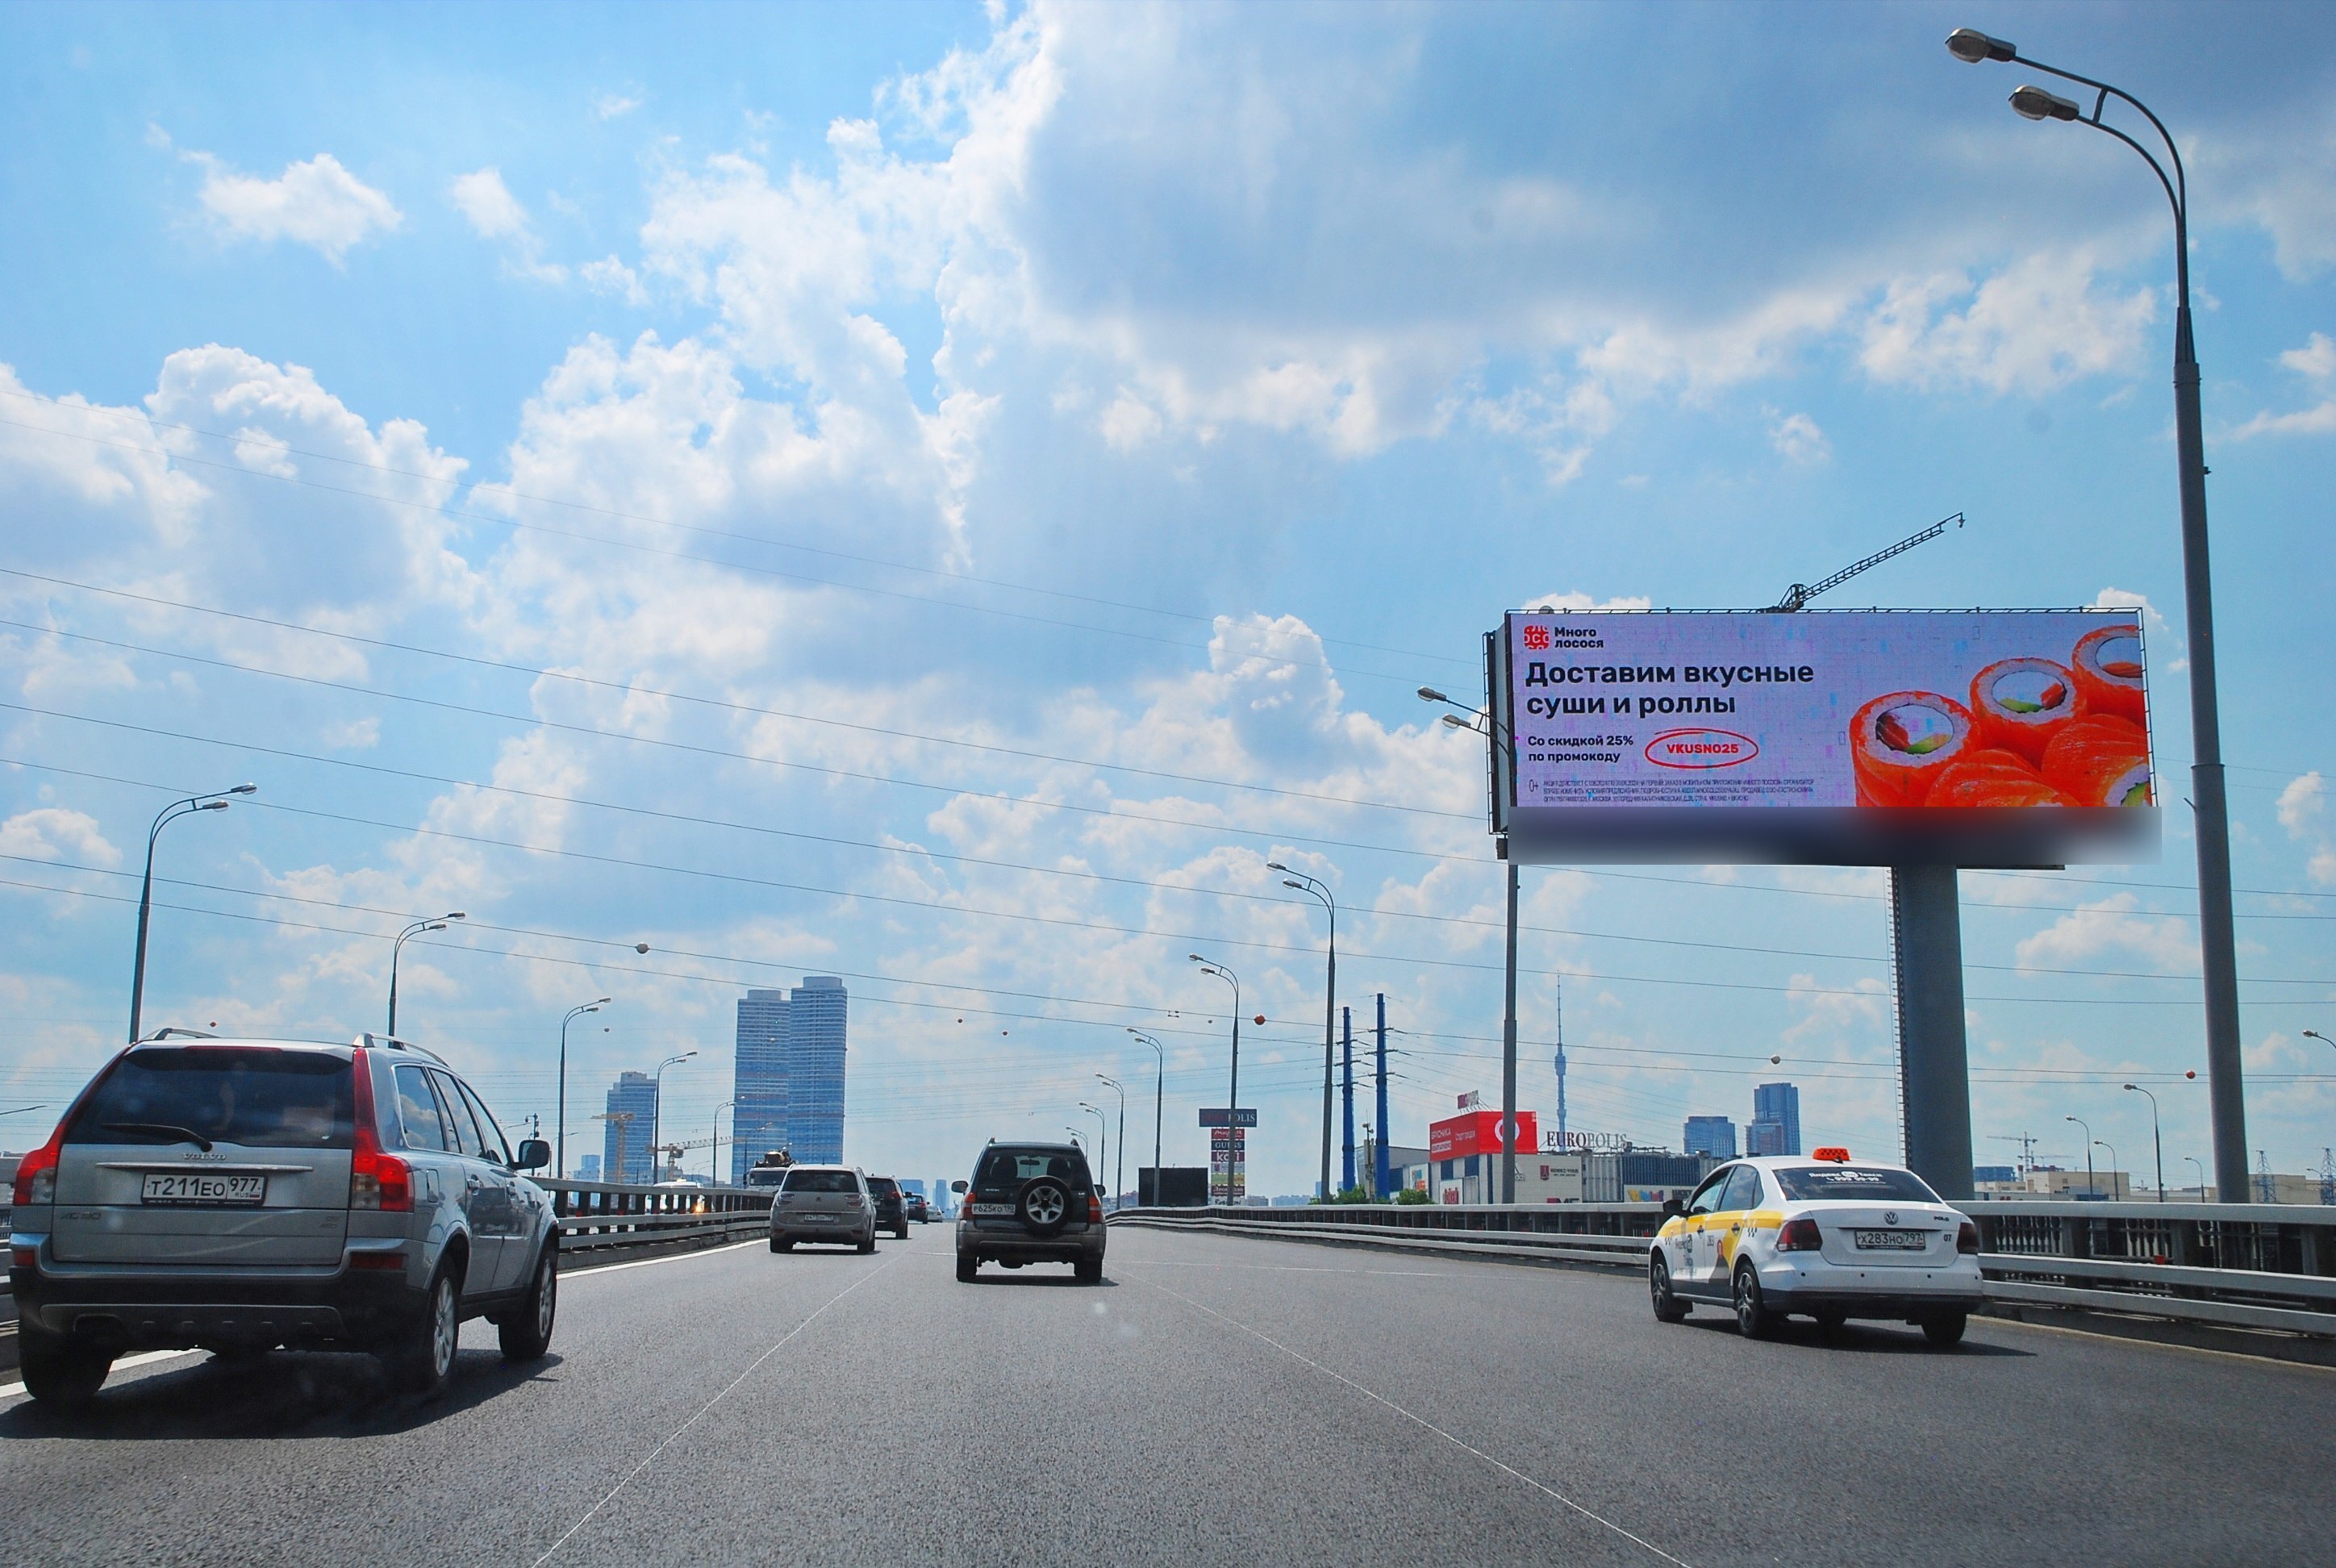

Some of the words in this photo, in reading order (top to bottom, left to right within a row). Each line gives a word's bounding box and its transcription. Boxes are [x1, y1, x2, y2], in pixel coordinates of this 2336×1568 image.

[1554, 627, 1596, 637] Много
[1554, 640, 1604, 648] лосося
[1525, 662, 1675, 687] Доставим
[1684, 665, 1814, 688] вкусные
[1527, 697, 1605, 719] суши
[1613, 697, 1631, 714] и
[1639, 696, 1736, 719] роллы
[1528, 736, 1545, 746] Со
[1548, 735, 1604, 747] скидкой
[1606, 735, 1634, 746] 25%
[1666, 744, 1739, 754] VKUSNO25
[1529, 753, 1545, 761] по
[1548, 753, 1621, 763] промокоду
[1546, 1131, 1627, 1149] EUROPOLIS
[183, 1153, 227, 1161] VOLVO
[229, 1178, 260, 1192] 977
[1904, 1232, 1921, 1242] 797
[1943, 1234, 1952, 1242] 07
